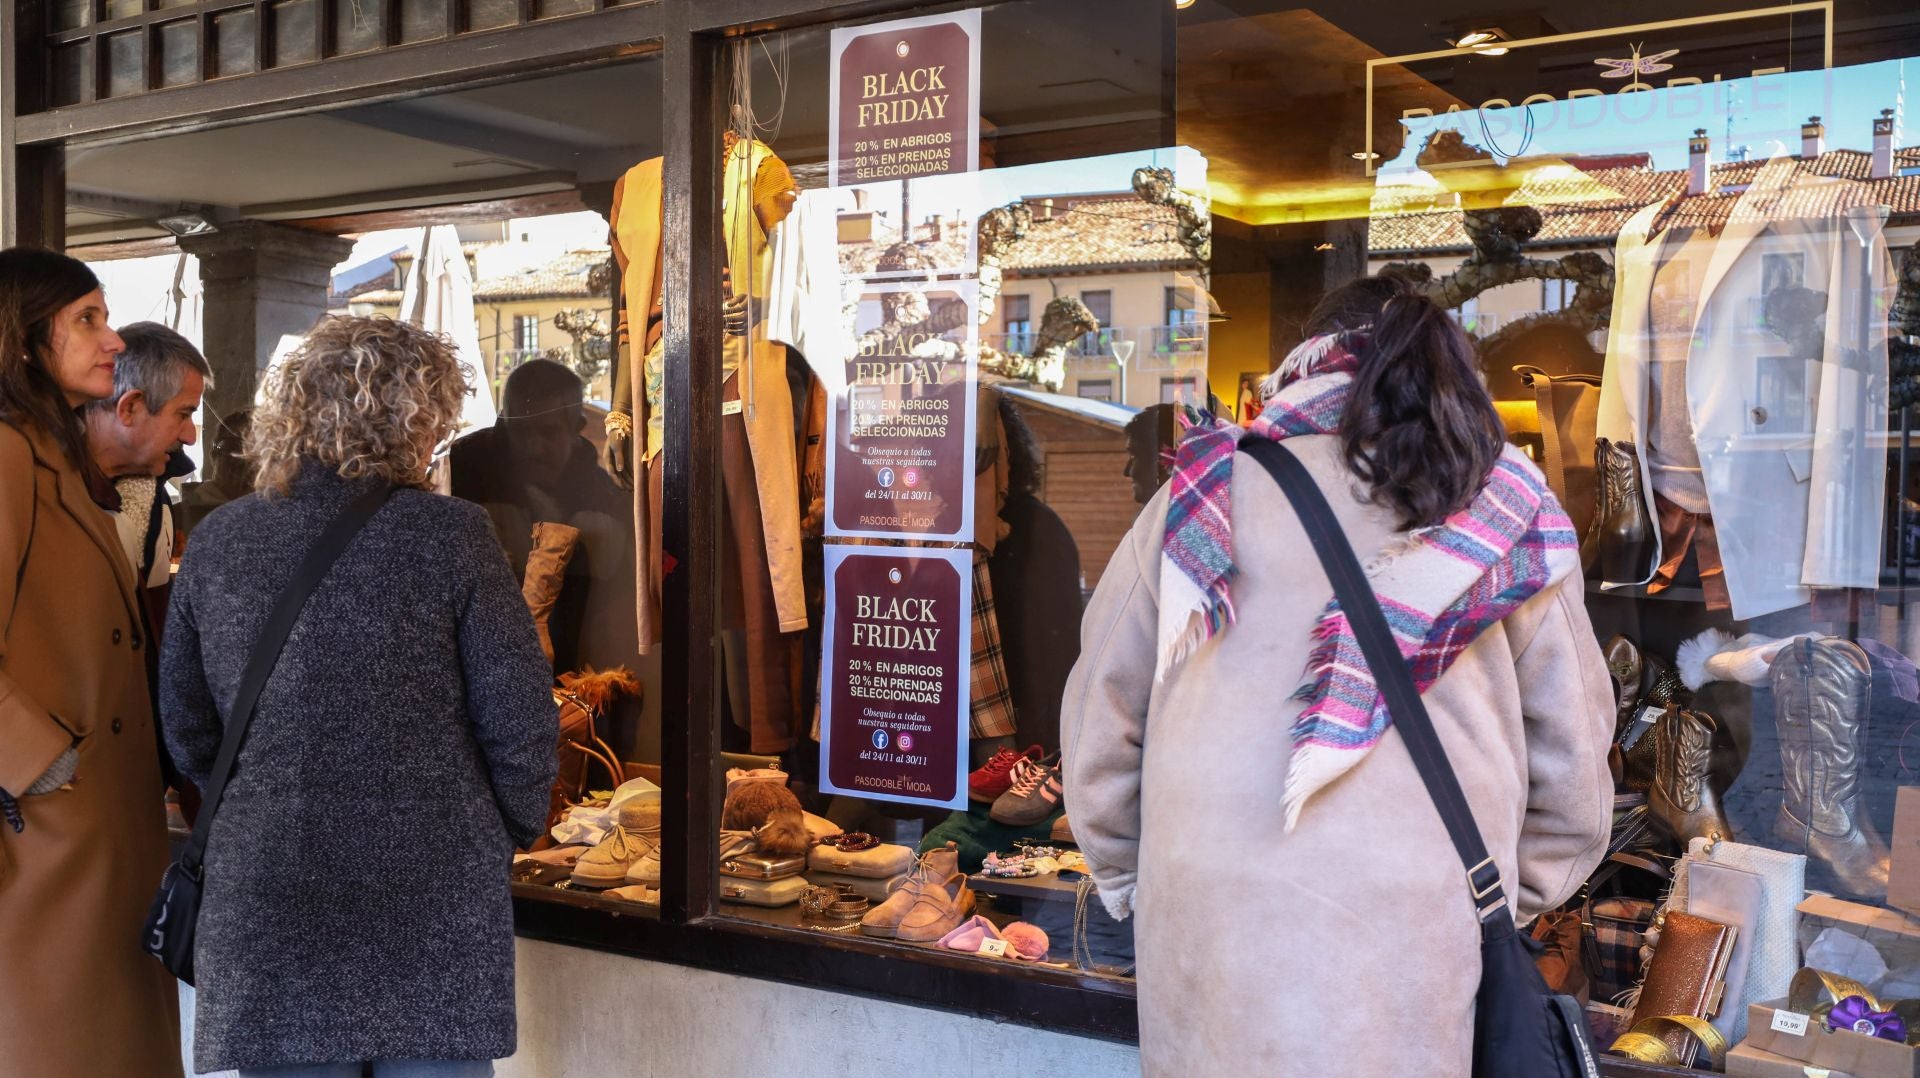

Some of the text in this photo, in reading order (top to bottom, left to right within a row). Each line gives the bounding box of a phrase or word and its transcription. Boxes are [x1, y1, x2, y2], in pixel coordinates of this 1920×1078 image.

[862, 65, 946, 99] BLACK
[857, 94, 950, 128] FRIDAY
[1402, 66, 1786, 148] PASODOBLE
[855, 132, 952, 153] 20 % EN ABRIGOS
[855, 147, 951, 168] 20 % EN PRENDAS
[856, 160, 949, 179] SELECCIONADAS
[855, 361, 948, 385] FRIDAY
[852, 399, 865, 410] 20
[880, 399, 896, 410] EN
[898, 399, 949, 411] ABRIGOS
[878, 414, 894, 426] EN
[896, 414, 949, 426] PRENDAS
[853, 426, 946, 438] SELECCIONADAS
[867, 446, 902, 458] Obsequio
[911, 447, 931, 457] todas
[862, 457, 937, 468] nuestras seguidoras
[865, 489, 932, 501] del 24/11 al 30/11
[911, 516, 936, 528] MODA
[856, 594, 938, 623] BLACK
[851, 622, 941, 652] FRIDAY
[848, 659, 943, 678] 20 % EN ABRIGOS
[848, 674, 943, 693] 20 % EN PRENDAS
[850, 685, 941, 704] SELECCIONADAS
[863, 707, 896, 721] Obsequio
[904, 711, 926, 722] todas
[857, 718, 932, 733] nuestras seguidoras
[860, 749, 927, 766] del 24/11 al 30/11
[854, 775, 932, 793] PASODOBLE MODA
